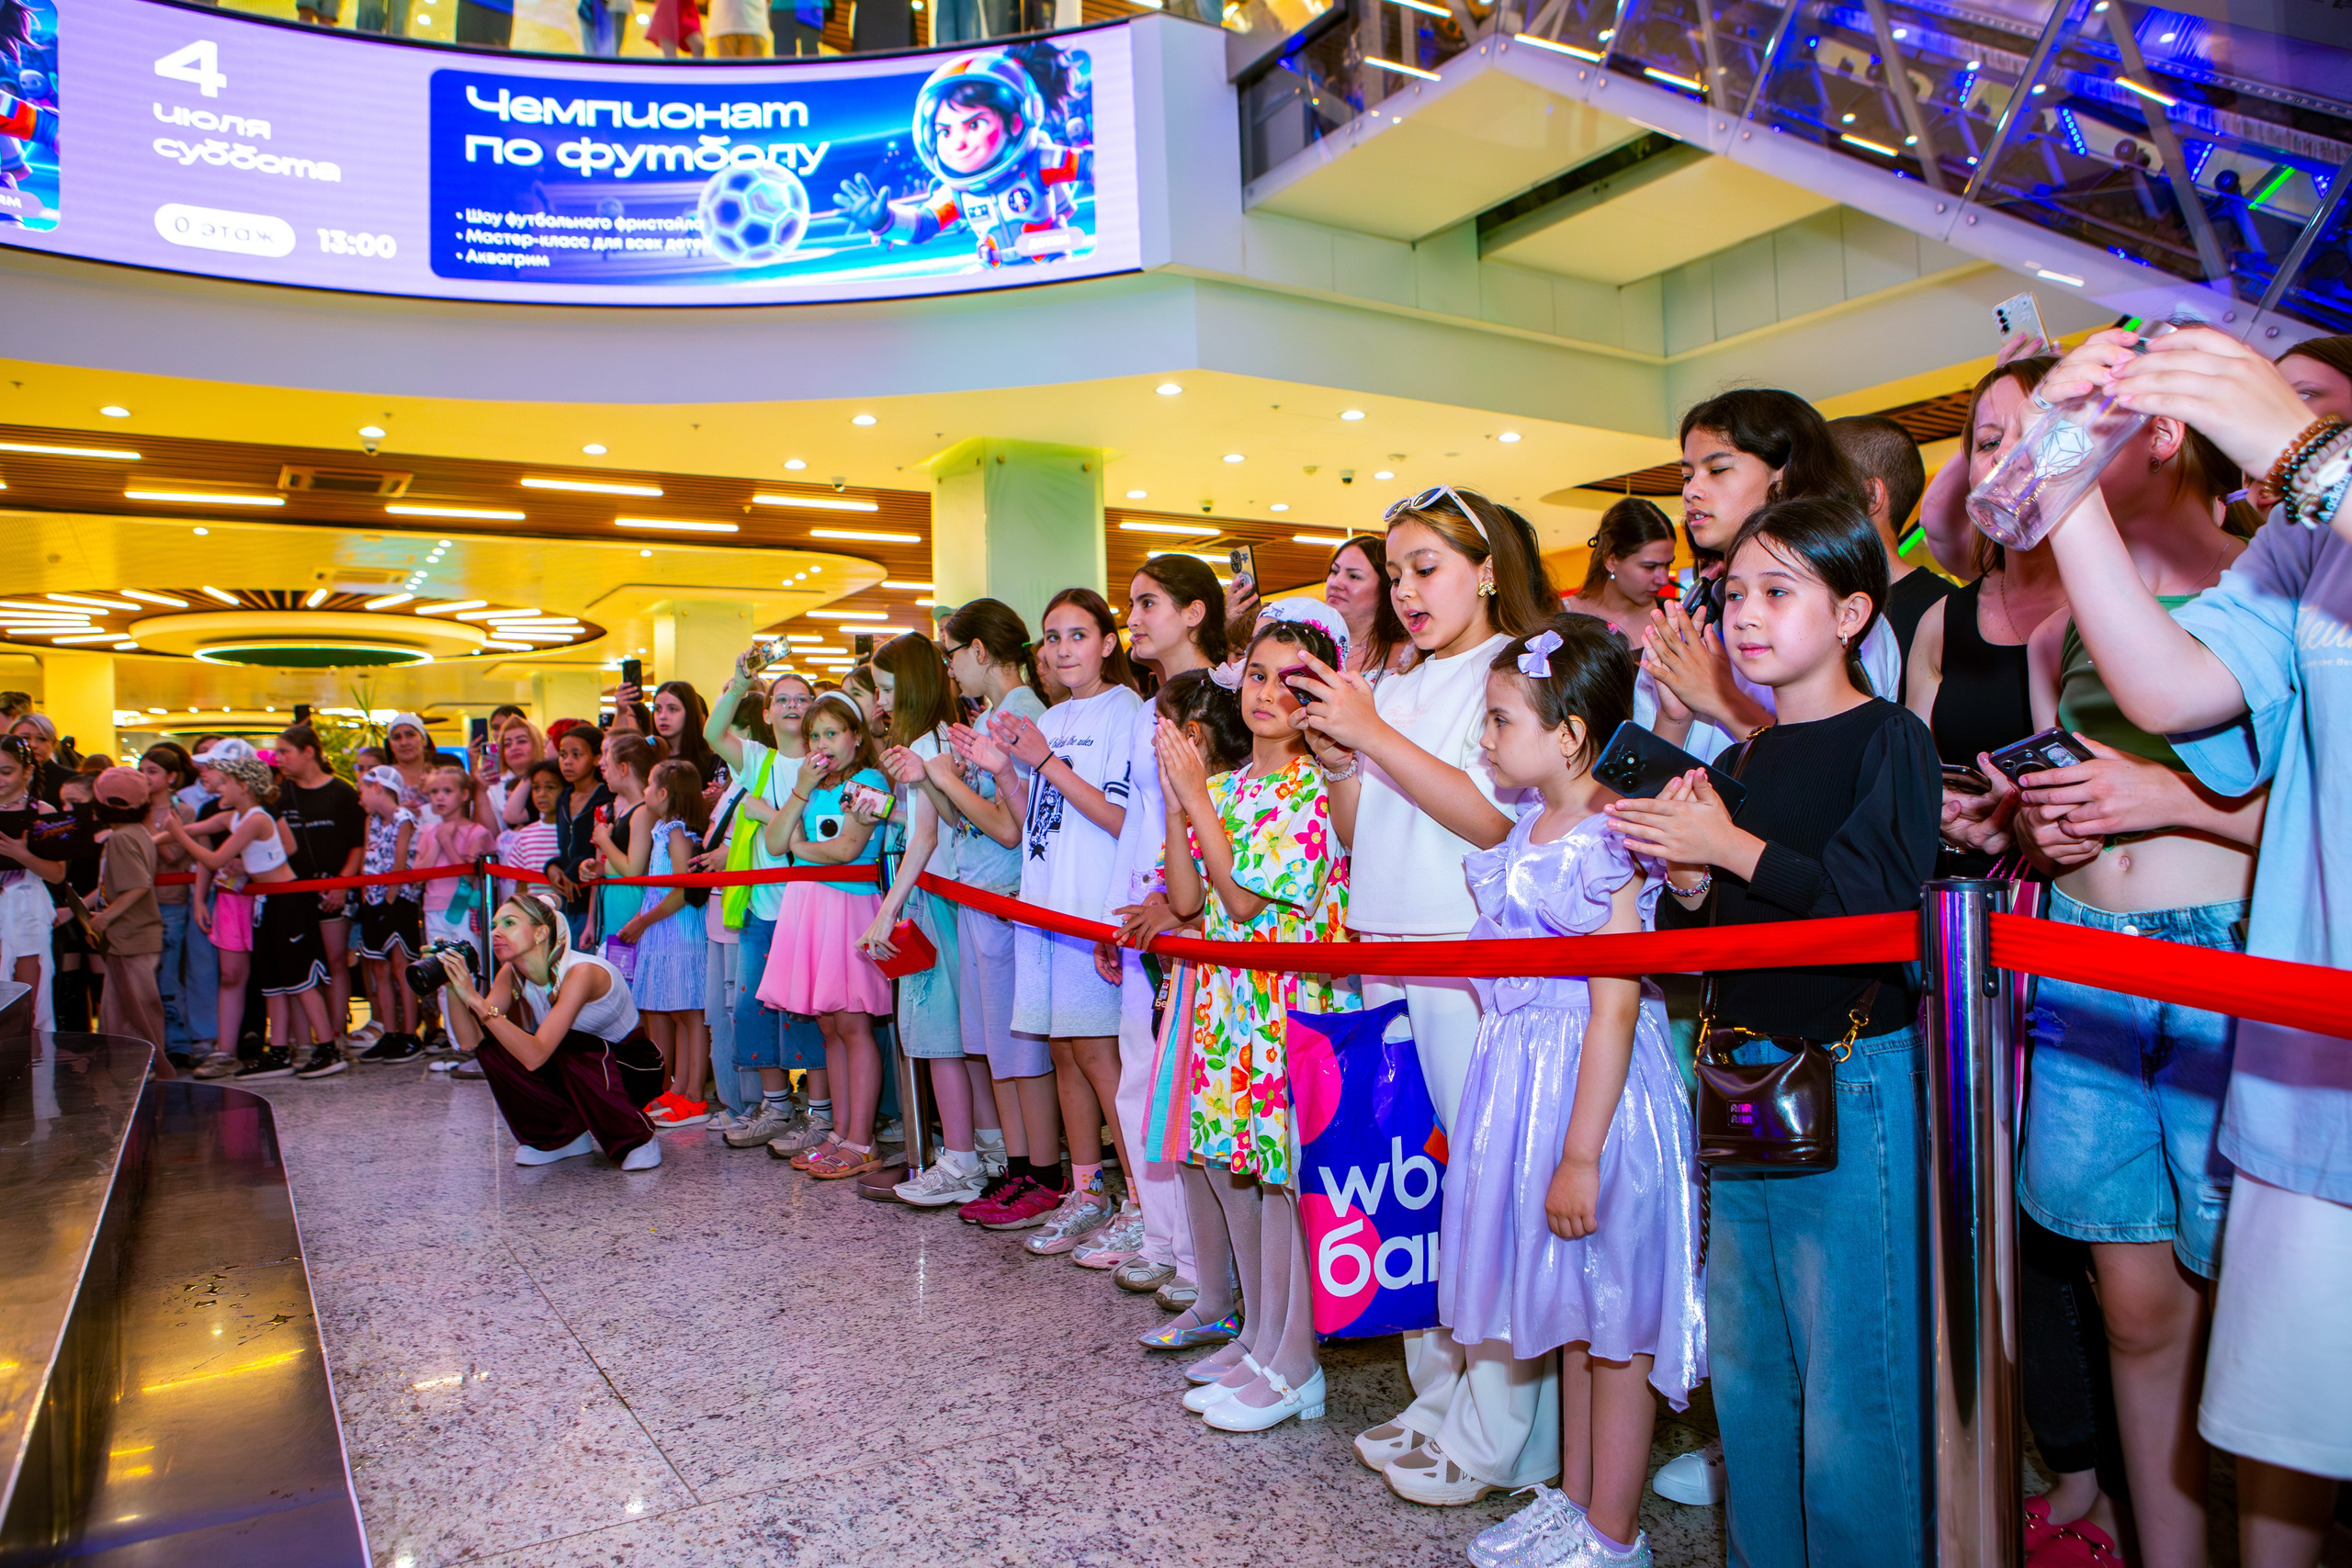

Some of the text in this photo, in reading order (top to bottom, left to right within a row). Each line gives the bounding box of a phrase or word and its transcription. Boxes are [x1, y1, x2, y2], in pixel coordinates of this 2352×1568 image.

[154, 39, 227, 98] 4
[153, 102, 272, 141] июля
[465, 85, 809, 130] Чемпионат
[153, 137, 342, 183] суббота
[465, 133, 831, 178] по футболу
[200, 219, 276, 246] этаж
[465, 208, 503, 228] Шоу
[504, 210, 614, 230] футбольного
[316, 227, 398, 260] 13:00
[465, 228, 591, 250] Мастер-класс
[592, 236, 624, 252] для
[625, 237, 663, 251] всех
[465, 248, 550, 269] Аквагрим
[1317, 1135, 1437, 1218] wb
